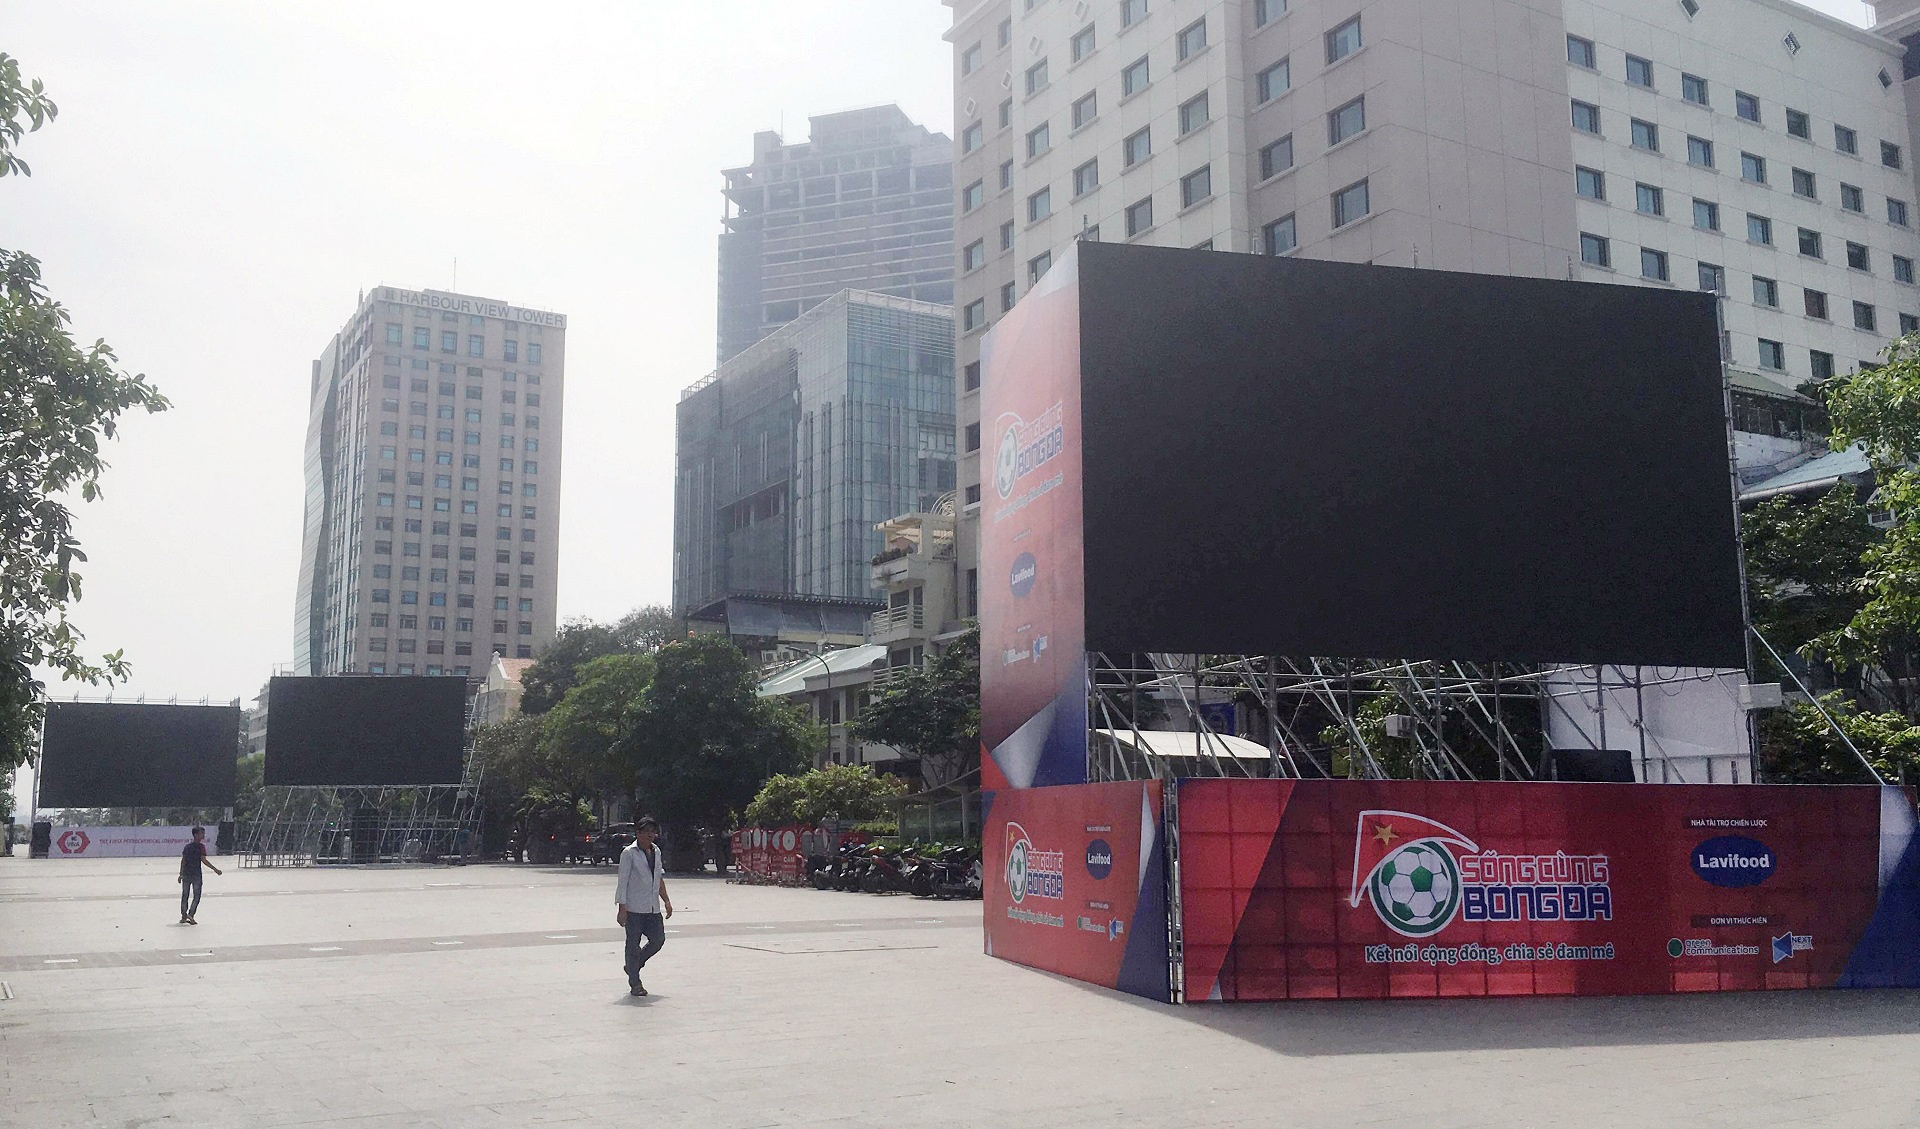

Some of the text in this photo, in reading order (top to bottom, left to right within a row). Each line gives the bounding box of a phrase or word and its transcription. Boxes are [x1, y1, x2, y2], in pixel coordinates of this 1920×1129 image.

[400, 290, 564, 327] HARBOUR VIEW TOWER
[1087, 852, 1112, 865] Lavifood
[1698, 854, 1770, 868] Lavifood
[1685, 939, 1712, 948] green
[1792, 935, 1812, 943] NEXT
[1365, 941, 1615, 966] Kết nối cộng đồng, chia sẻ đam mê
[1685, 945, 1760, 956] communications
